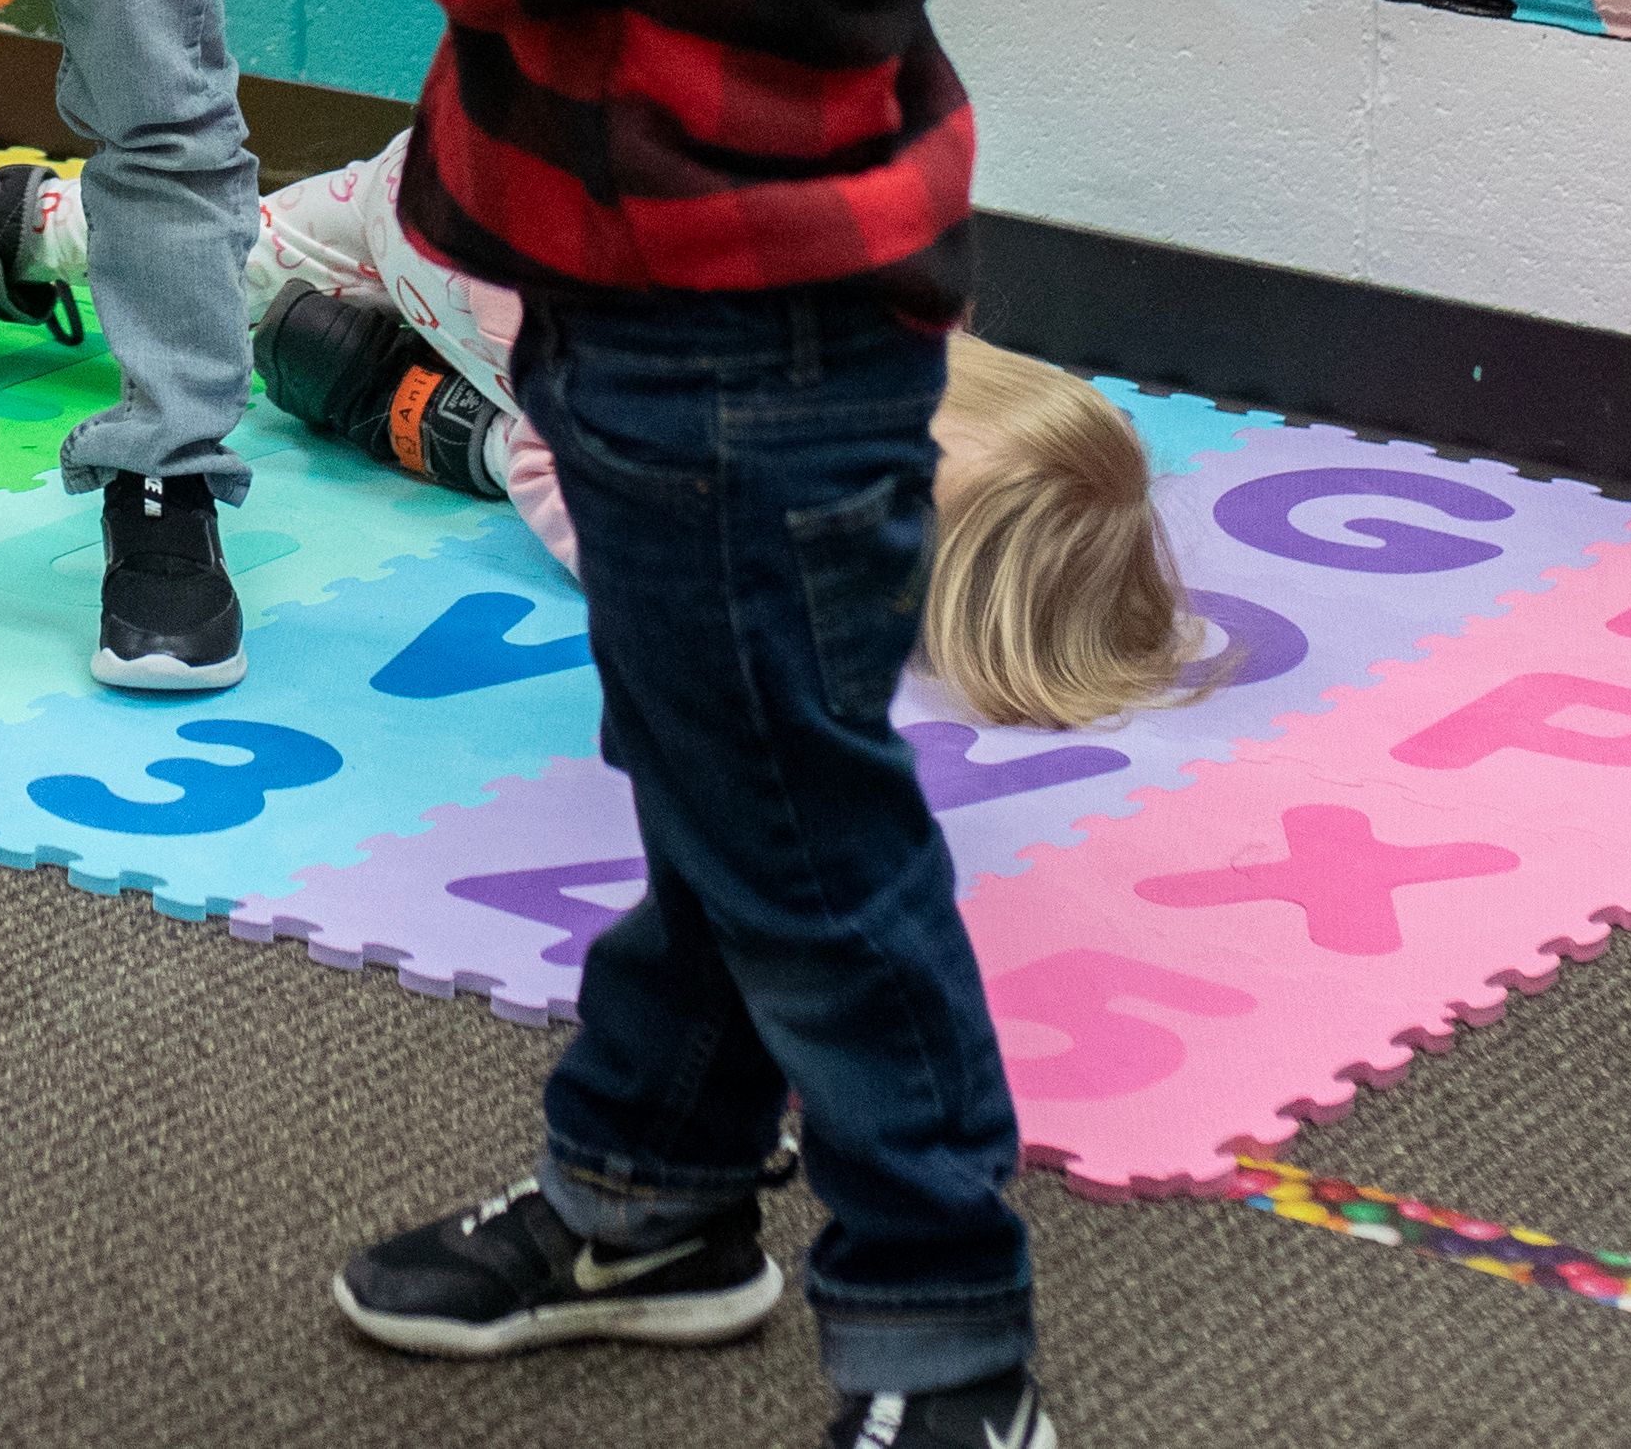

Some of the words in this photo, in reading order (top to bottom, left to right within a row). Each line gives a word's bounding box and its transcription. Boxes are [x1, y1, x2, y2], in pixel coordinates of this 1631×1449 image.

[1213, 467, 1515, 574] G
[27, 720, 343, 835] 3
[1134, 804, 1520, 955] X
